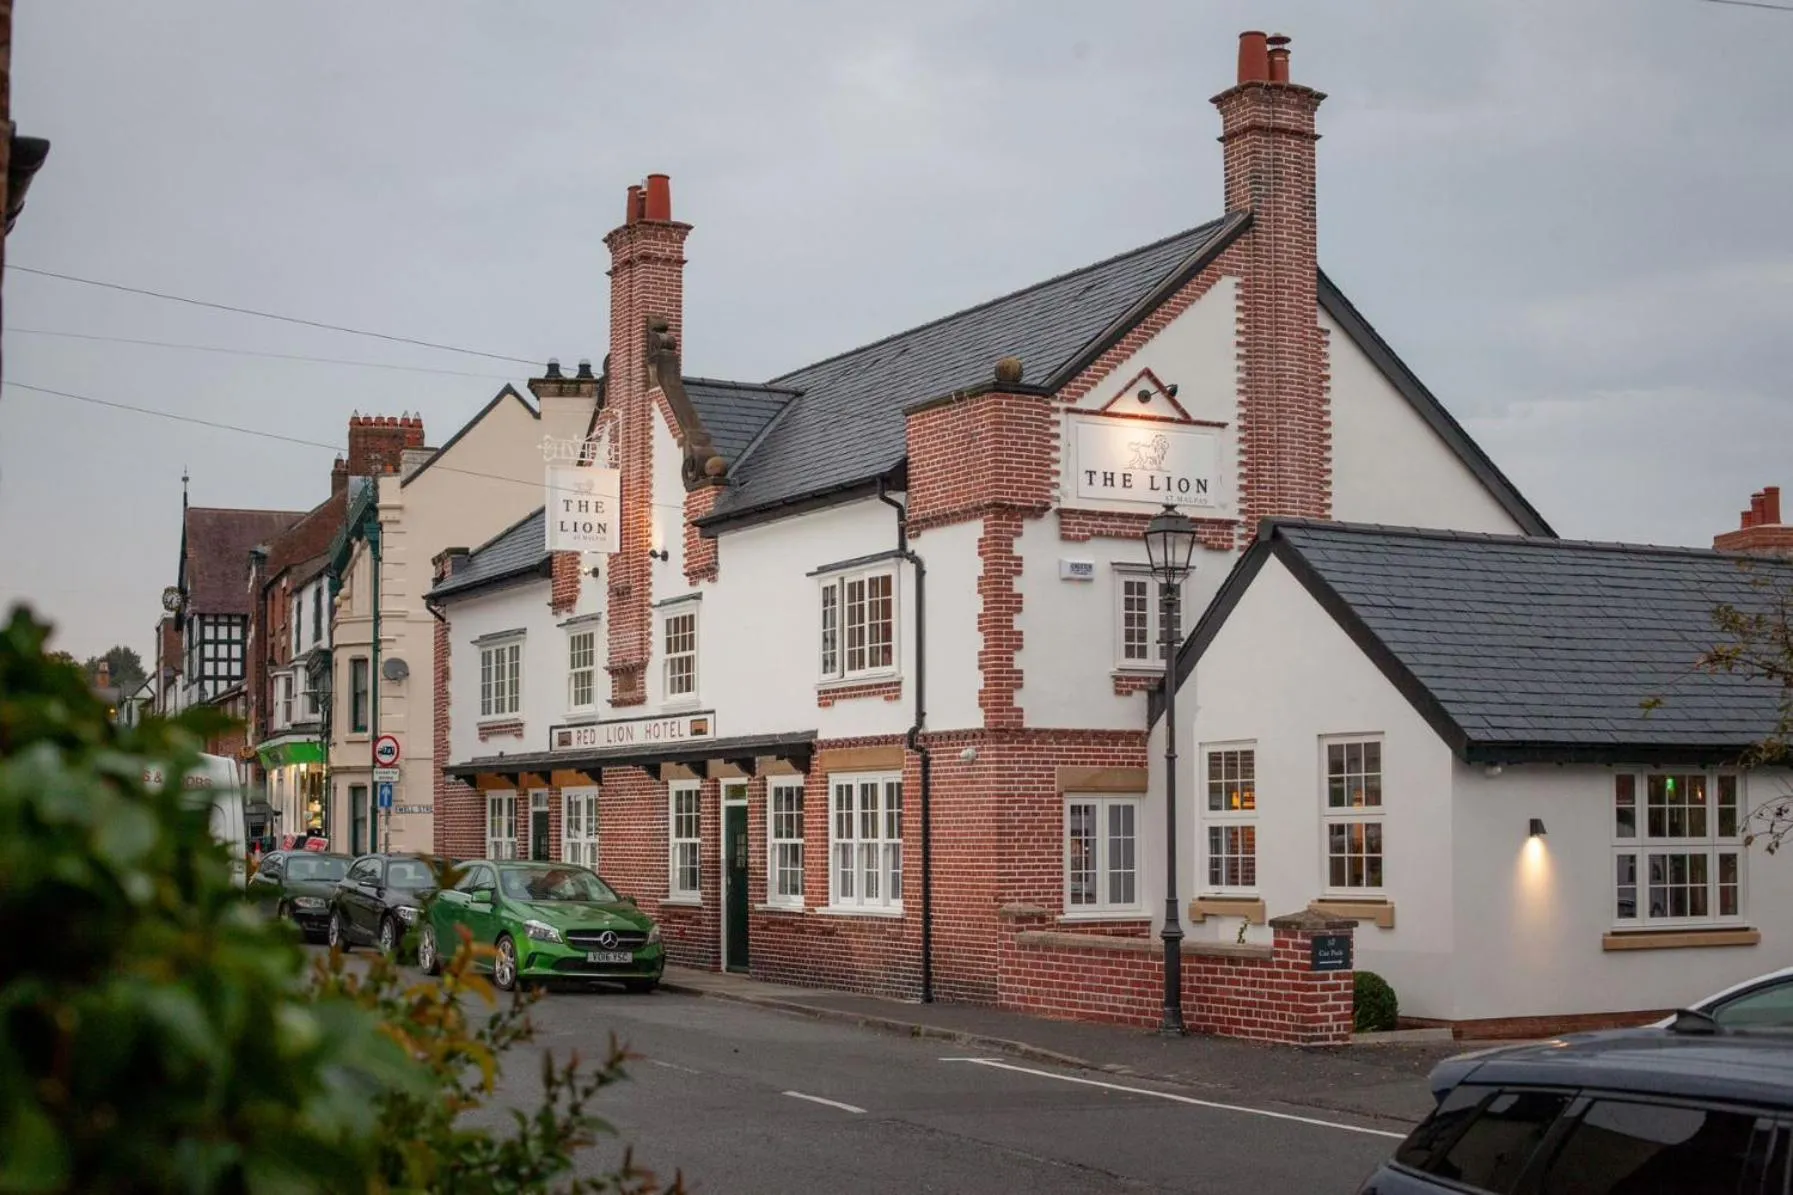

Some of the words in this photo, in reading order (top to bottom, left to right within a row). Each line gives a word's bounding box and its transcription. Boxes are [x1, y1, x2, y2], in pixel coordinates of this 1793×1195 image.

[1085, 470, 1133, 489] THE
[1149, 475, 1208, 494] LION
[562, 499, 605, 513] THE
[560, 520, 607, 534] LION
[576, 729, 596, 746] RED
[606, 725, 634, 744] LION
[645, 720, 684, 739] HOTEL
